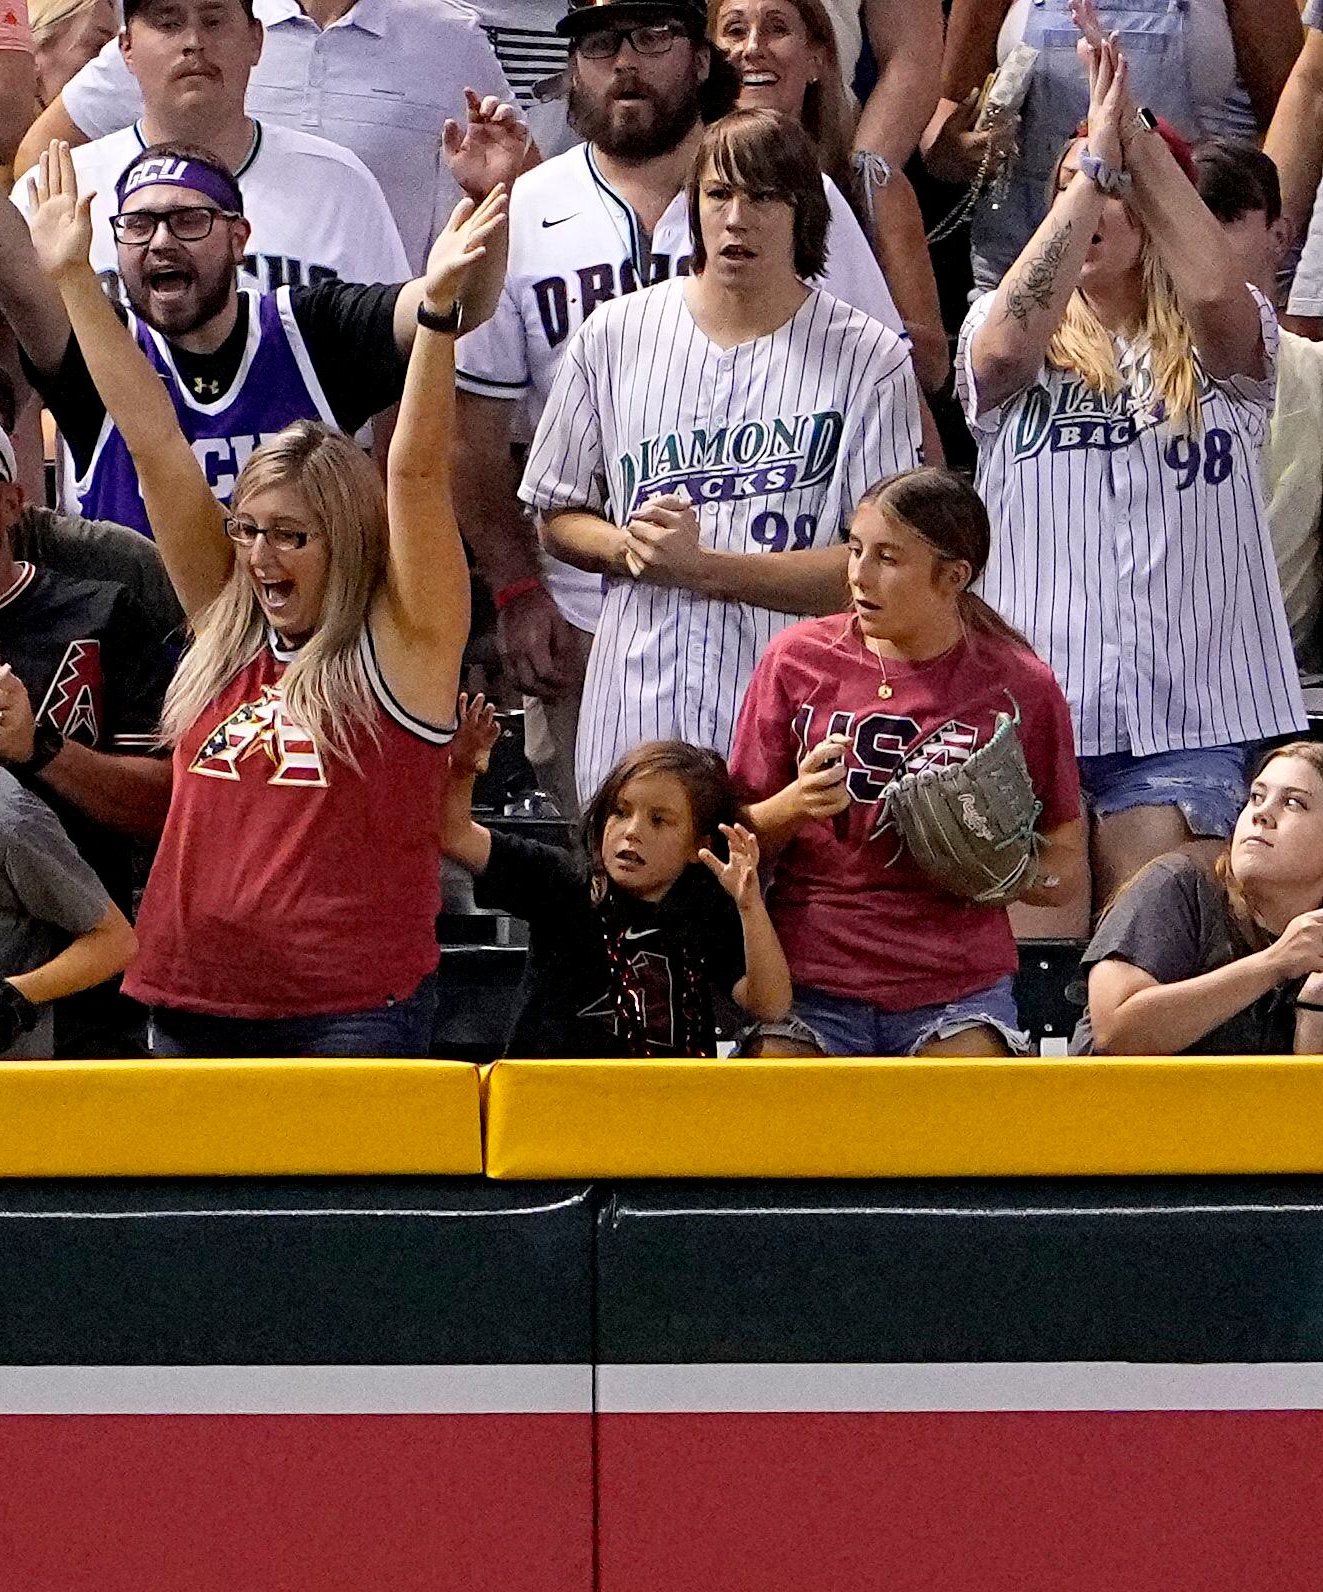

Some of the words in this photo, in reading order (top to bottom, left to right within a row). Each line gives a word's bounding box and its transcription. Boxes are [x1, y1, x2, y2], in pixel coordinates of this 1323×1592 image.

[124, 158, 189, 194] GCU
[1164, 428, 1234, 490] 98
[791, 703, 979, 805] USA
